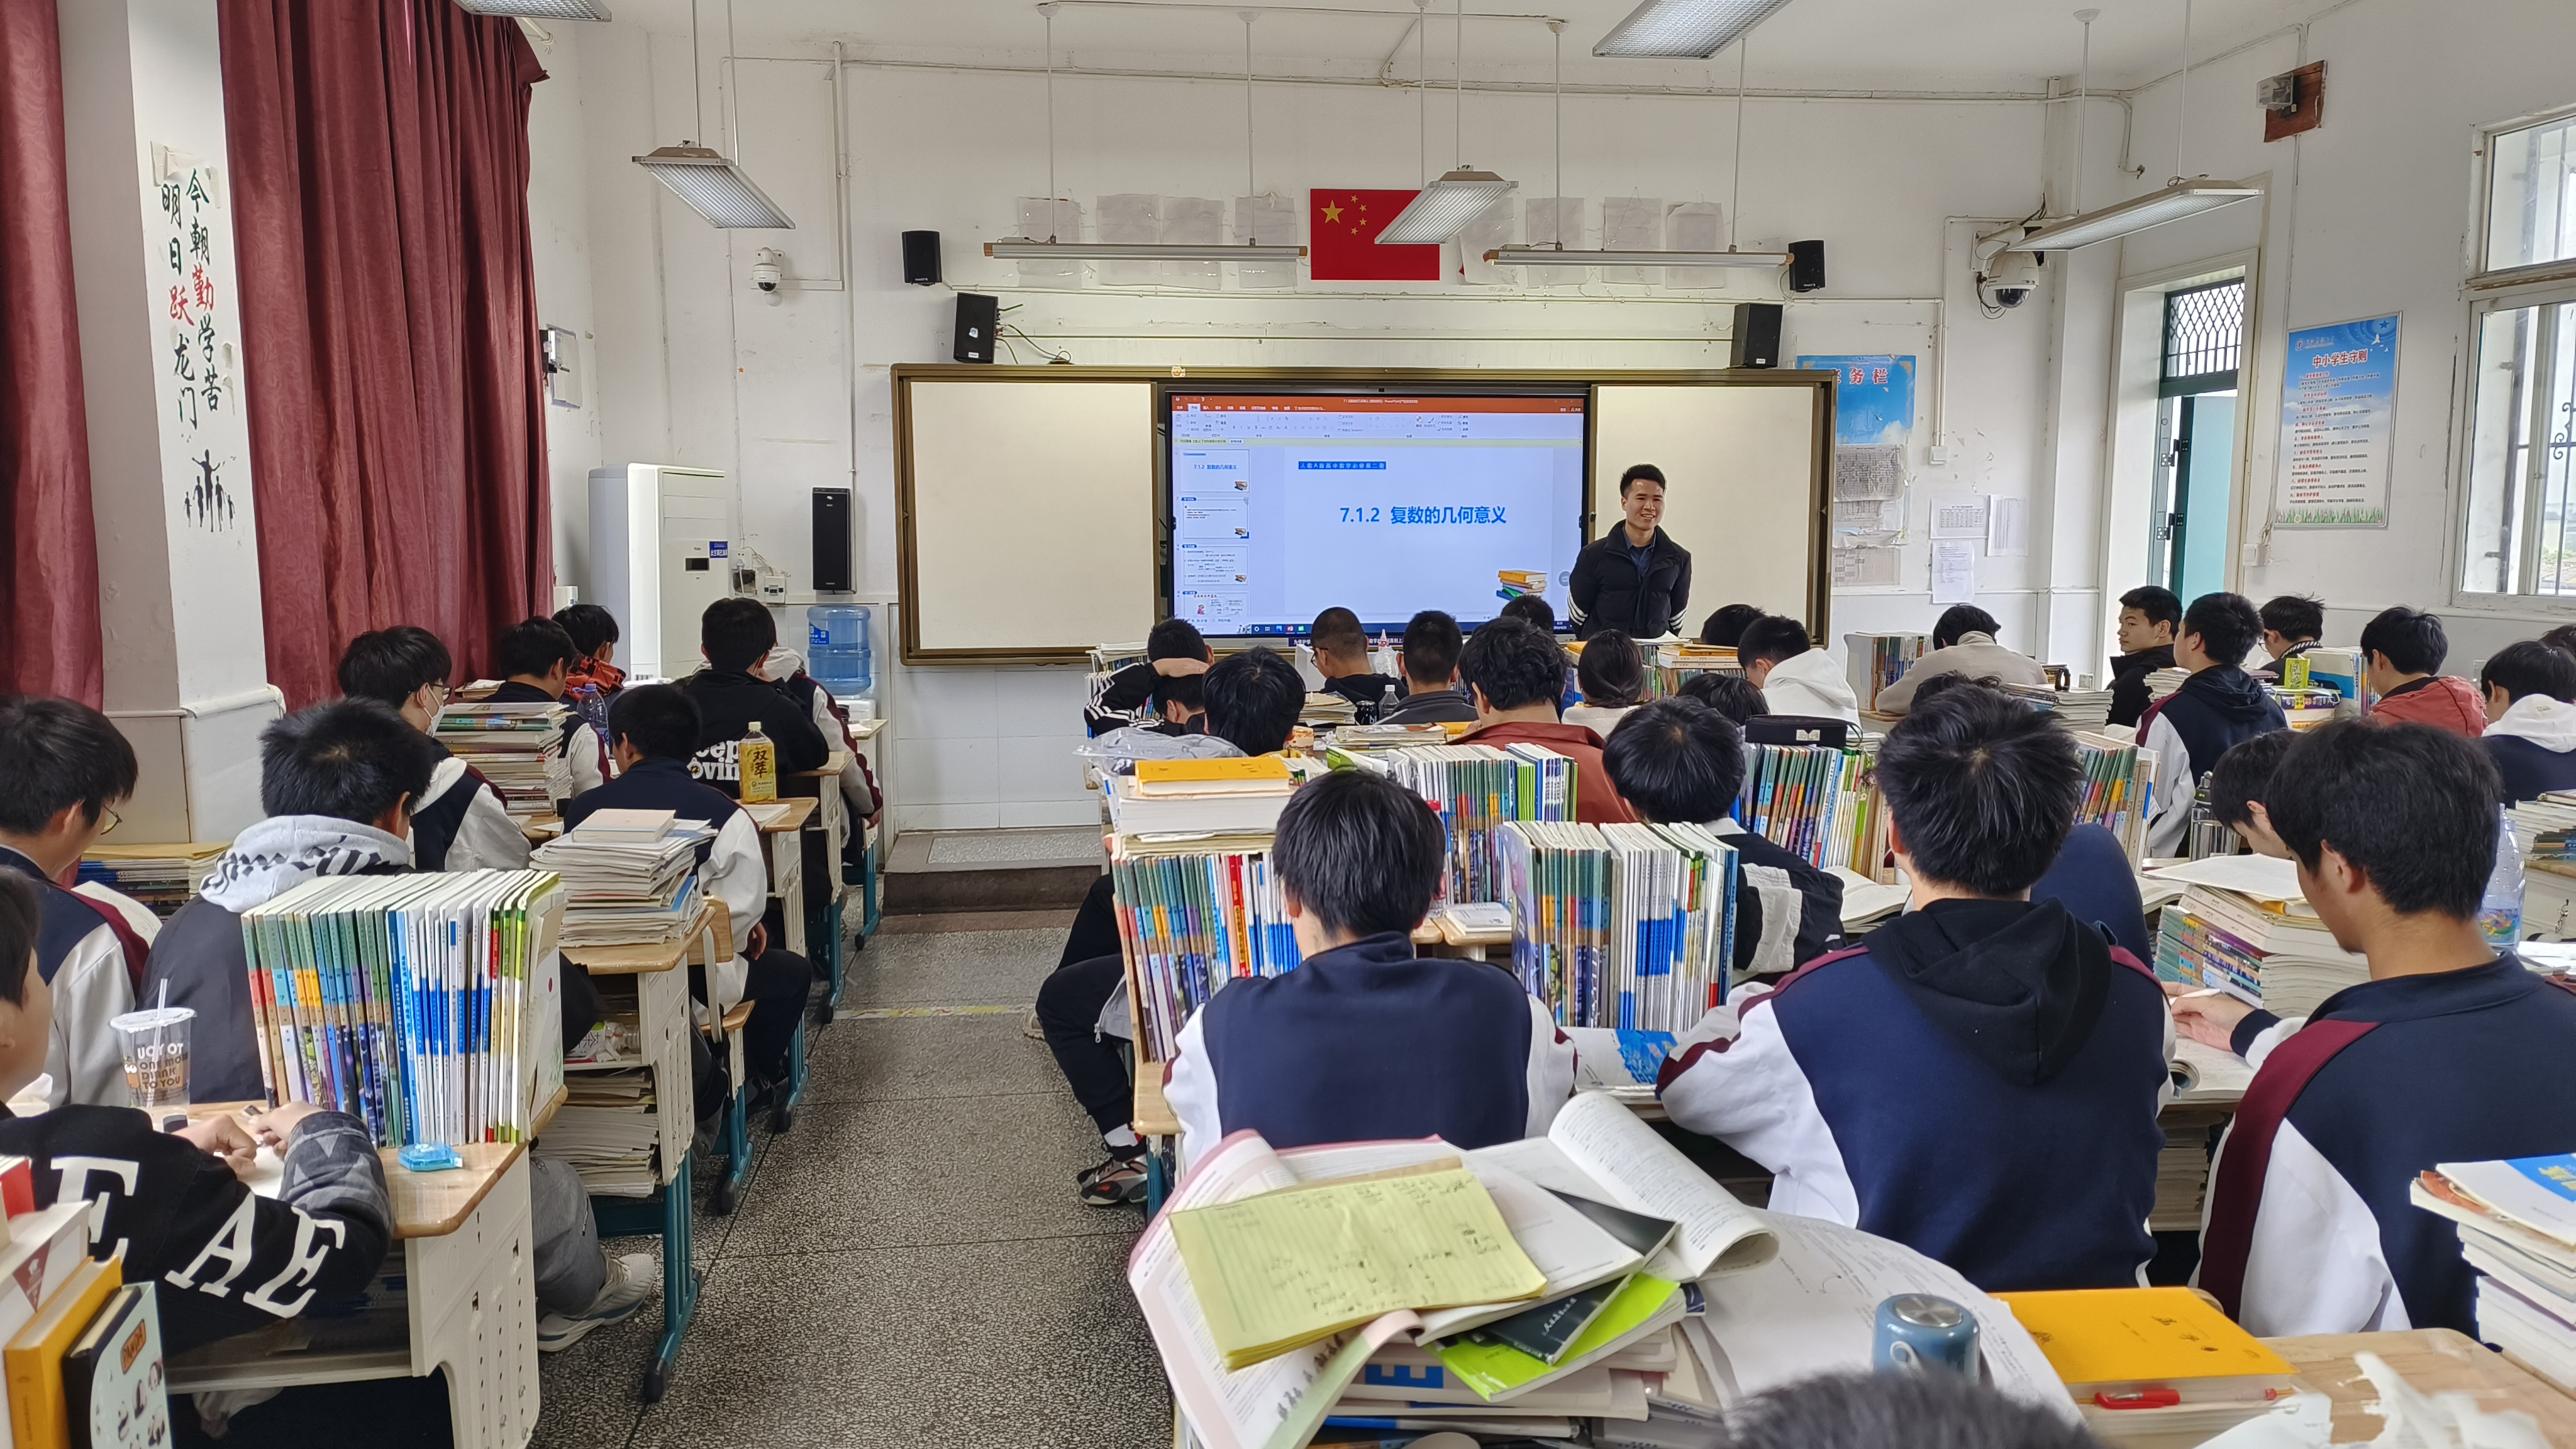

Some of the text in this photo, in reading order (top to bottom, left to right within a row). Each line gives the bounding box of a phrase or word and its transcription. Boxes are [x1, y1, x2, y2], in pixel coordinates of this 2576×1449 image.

[186, 167, 222, 412] 今朝勤学苦
[160, 184, 197, 431] 明日跃龙门
[2312, 348, 2368, 369] 中小学生守则
[1340, 504, 1507, 525] 7.1.2 复数的几何意义
[753, 750, 769, 779] 双萃
